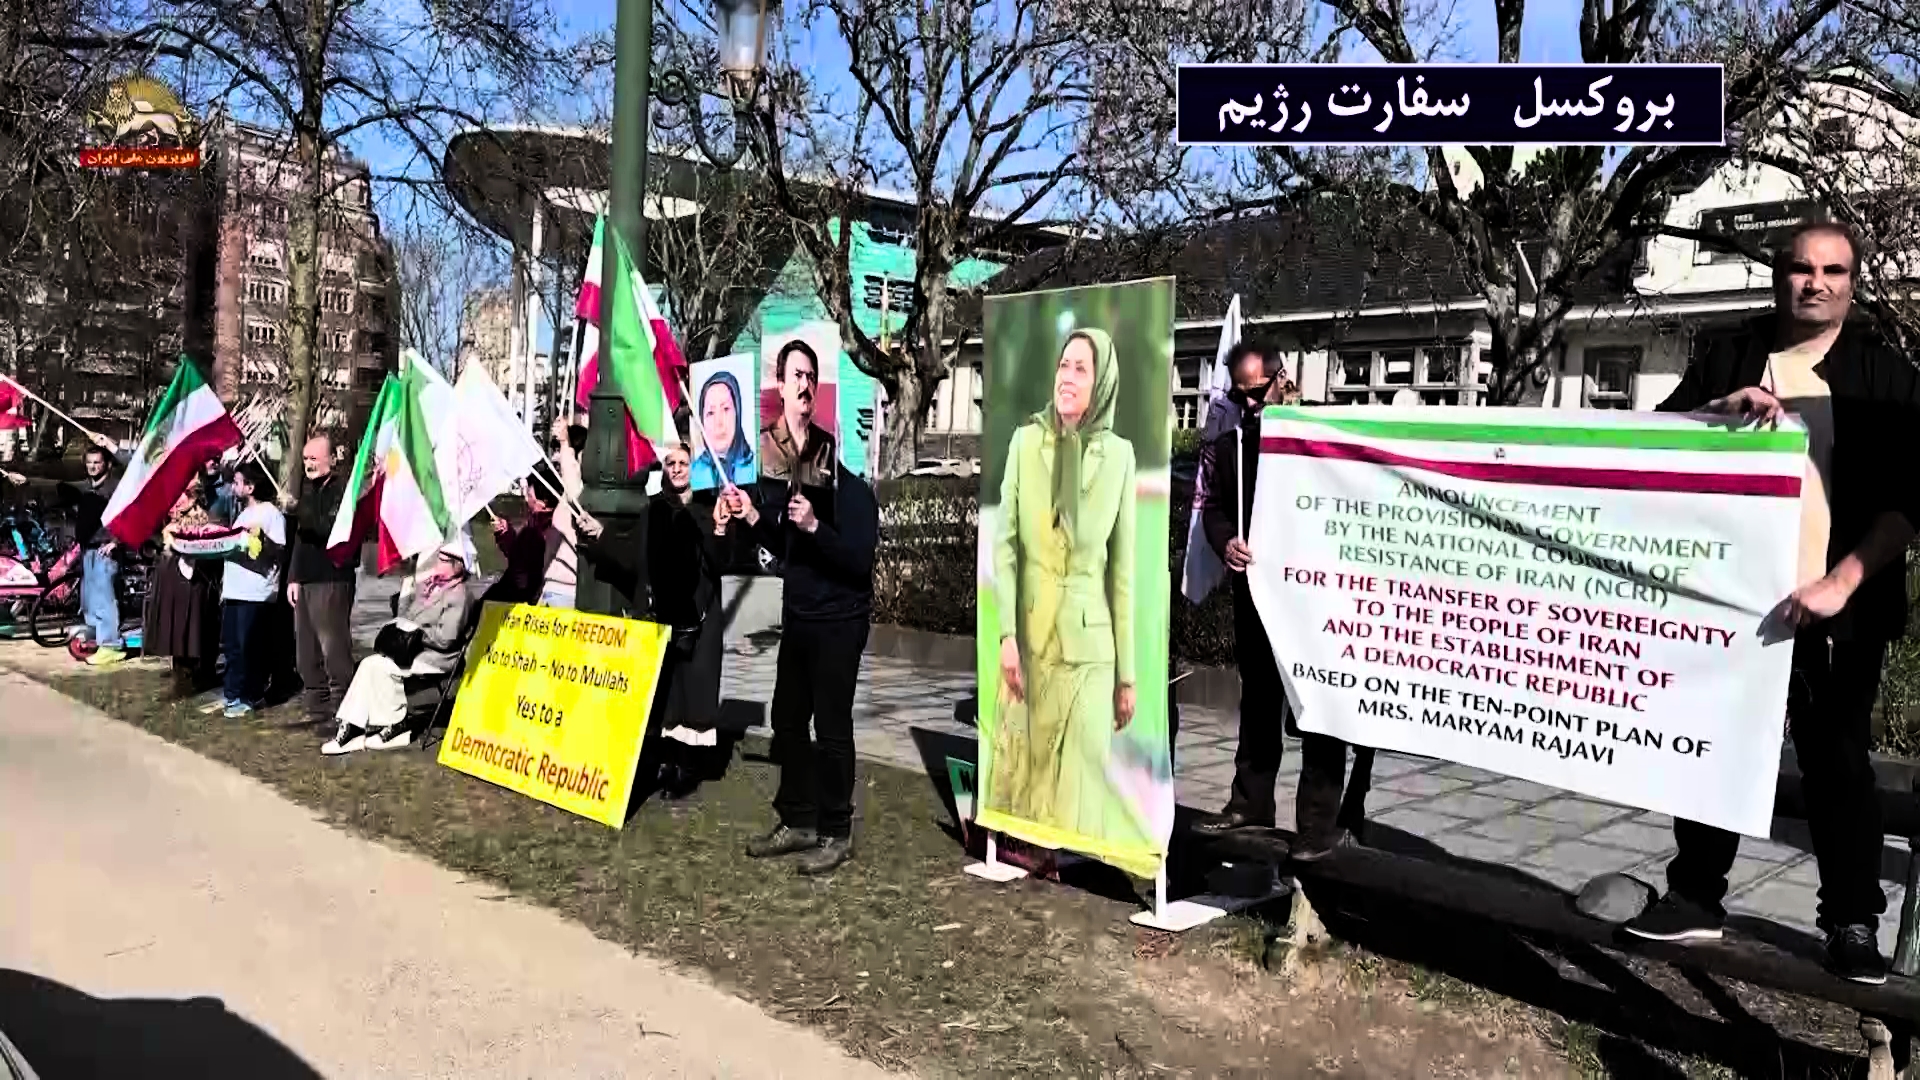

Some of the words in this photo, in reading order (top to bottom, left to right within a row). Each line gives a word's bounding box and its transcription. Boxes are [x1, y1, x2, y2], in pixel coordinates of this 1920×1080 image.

[1295, 495, 1327, 511] OF
[1332, 497, 1372, 518] THE
[1378, 503, 1531, 537] PROVISIONAL
[1535, 525, 1732, 560] GOVERNMENT
[1397, 481, 1601, 524] ANNOUNCEMENT
[1324, 519, 1352, 538] BY
[1357, 523, 1399, 544] THE
[1404, 531, 1524, 560] NATIONAL
[1532, 543, 1636, 576] COUNCIL
[1649, 564, 1689, 587] OF
[1339, 544, 1469, 577] RESISTANCE
[1476, 563, 1508, 582] OF
[1516, 567, 1575, 592] IRAN
[1585, 576, 1668, 610] (NCRI)
[522, 613, 550, 635] Rises
[552, 617, 568, 637] for
[570, 620, 627, 648] FREEDOM
[1284, 567, 1326, 587] FOR
[1335, 573, 1378, 592] THE
[1385, 579, 1500, 612] TRANSFER
[1507, 597, 1540, 617] OF
[1548, 603, 1736, 648] SOVEREIGNTY
[1353, 598, 1384, 616] TO
[1392, 603, 1434, 624] THE
[1442, 611, 1529, 640] PEOPLE
[1537, 627, 1571, 645] OF
[1579, 632, 1641, 659] IRAN
[484, 642, 499, 665] No
[499, 649, 510, 668] to
[511, 650, 537, 673] Shah
[549, 658, 565, 681] No
[566, 663, 578, 682] to
[579, 665, 629, 693] Mullahs
[1322, 618, 1372, 638] AND
[1380, 625, 1423, 646] THE
[1431, 633, 1629, 682] ESTABLISHMENT
[1638, 669, 1675, 689] OF
[1341, 644, 1356, 660] A
[1364, 647, 1518, 687] DEMOCRATIC
[1526, 673, 1648, 712] REPUBLIC
[516, 694, 537, 721] Yes
[539, 702, 554, 725] to
[555, 709, 563, 727] a
[1292, 662, 1357, 688] BASED
[1364, 676, 1400, 696] ON
[1408, 682, 1452, 705] THE
[1457, 691, 1588, 732] TEN-POINT
[1596, 720, 1662, 750] PLAN
[1672, 735, 1712, 758] OF
[1358, 699, 1413, 722] MRS.
[1422, 708, 1523, 745] MARYAM
[1532, 731, 1614, 765] RAJAVI
[451, 727, 535, 777] Democratic
[536, 751, 609, 802] Republic
